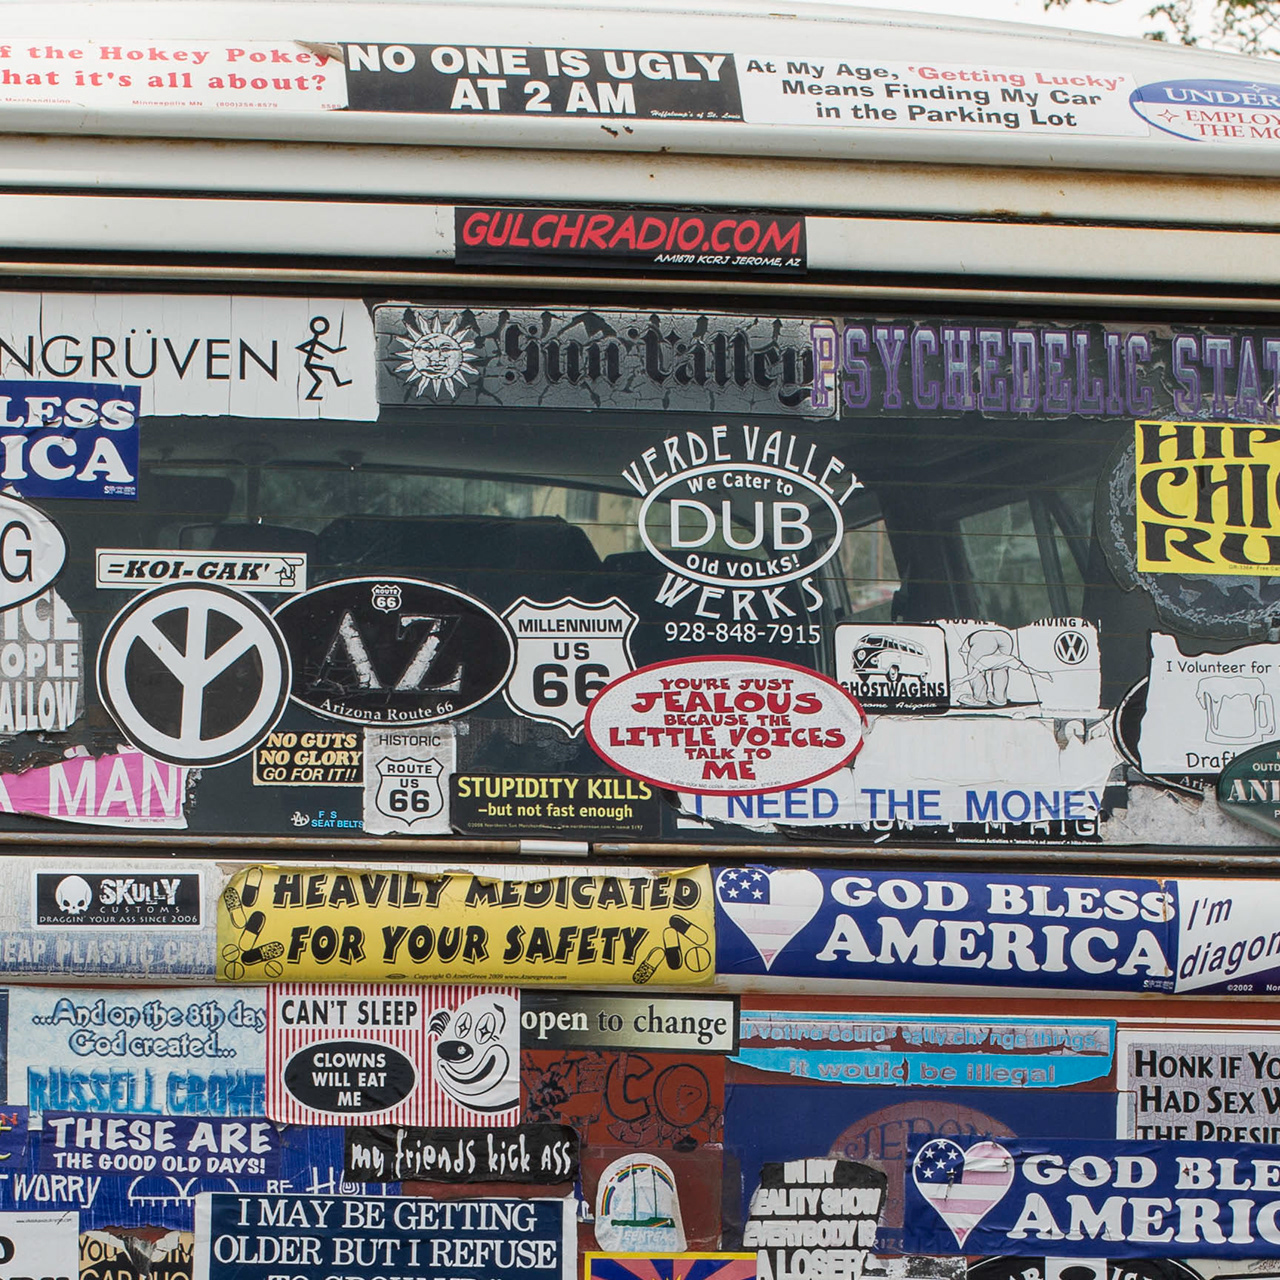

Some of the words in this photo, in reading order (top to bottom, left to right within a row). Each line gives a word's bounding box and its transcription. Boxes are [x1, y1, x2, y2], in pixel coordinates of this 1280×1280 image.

[28, 46, 84, 61] the
[99, 46, 208, 65] Hokey
[226, 48, 331, 68] Pokey
[348, 45, 416, 73] NO
[430, 47, 528, 77] ONE
[544, 50, 591, 77] IS
[604, 52, 728, 82] UGLY
[74, 69, 133, 88] it's
[147, 71, 193, 89] all
[207, 73, 327, 91] about?
[450, 79, 507, 110] AT
[525, 82, 553, 112] 2
[564, 83, 636, 114] AM
[1194, 124, 1234, 139] THE
[462, 211, 801, 255] GULCHRADIO.COM
[654, 253, 695, 264] AM1670
[697, 255, 730, 264] KCRJ
[732, 256, 782, 267] JEROME,
[785, 257, 801, 266] AZ
[622, 426, 733, 497] VERDE
[742, 426, 864, 505] VALLEY
[687, 477, 717, 494] We
[722, 473, 772, 490] Cater
[776, 480, 795, 496] to
[671, 499, 814, 552] DUB
[687, 555, 719, 576] Old
[725, 555, 801, 577] VOLKS!
[656, 572, 824, 621] WERKS
[518, 617, 624, 634] MILLENNIUM
[665, 622, 821, 645] 928-848-7915
[553, 642, 591, 661] US
[532, 663, 613, 706] 66
[458, 777, 581, 800] STUPIDITY
[587, 780, 652, 801] KILLS
[518, 805, 540, 818] not
[544, 804, 572, 818] fast
[574, 804, 634, 821] enough
[274, 874, 452, 909] HEAVILY
[466, 877, 703, 911] MEDICATED
[1186, 894, 1232, 931] I'm
[288, 925, 365, 964] FOR
[381, 925, 491, 964] YOUR
[503, 925, 650, 964] SAFETY
[281, 1000, 349, 1026] CAN'T
[358, 1000, 418, 1026] SLEEP
[521, 1011, 588, 1041] open
[597, 1010, 623, 1032] to
[633, 1007, 728, 1051] change
[313, 1053, 386, 1069] CLOWNS
[312, 1072, 353, 1088] WILL
[357, 1072, 387, 1088] EAT
[338, 1090, 362, 1107] ME
